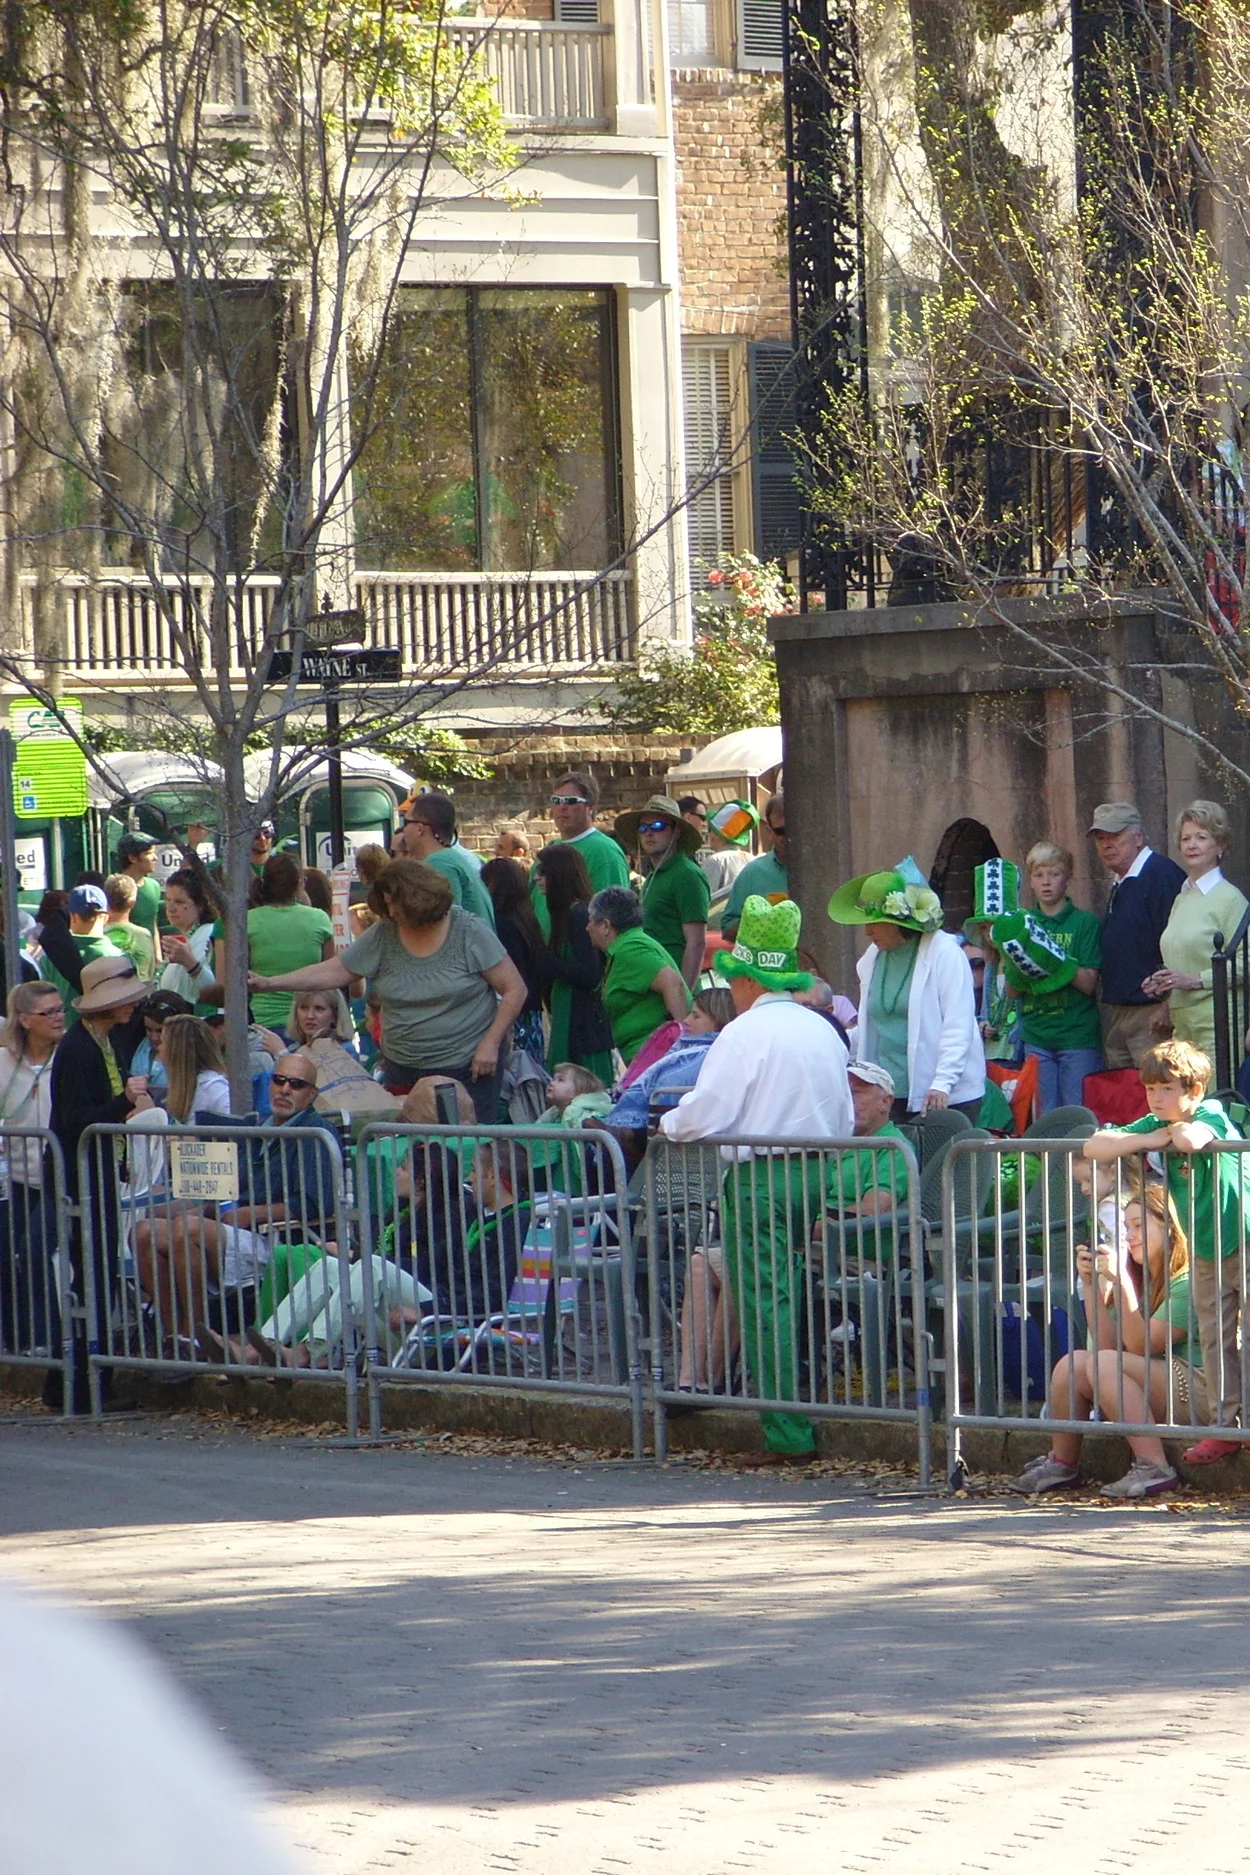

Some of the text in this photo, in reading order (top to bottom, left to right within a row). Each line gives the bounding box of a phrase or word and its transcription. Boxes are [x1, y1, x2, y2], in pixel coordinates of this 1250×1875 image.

[758, 951, 786, 967] DAY
[180, 1161, 233, 1175] NATIONWIDE RENTALS
